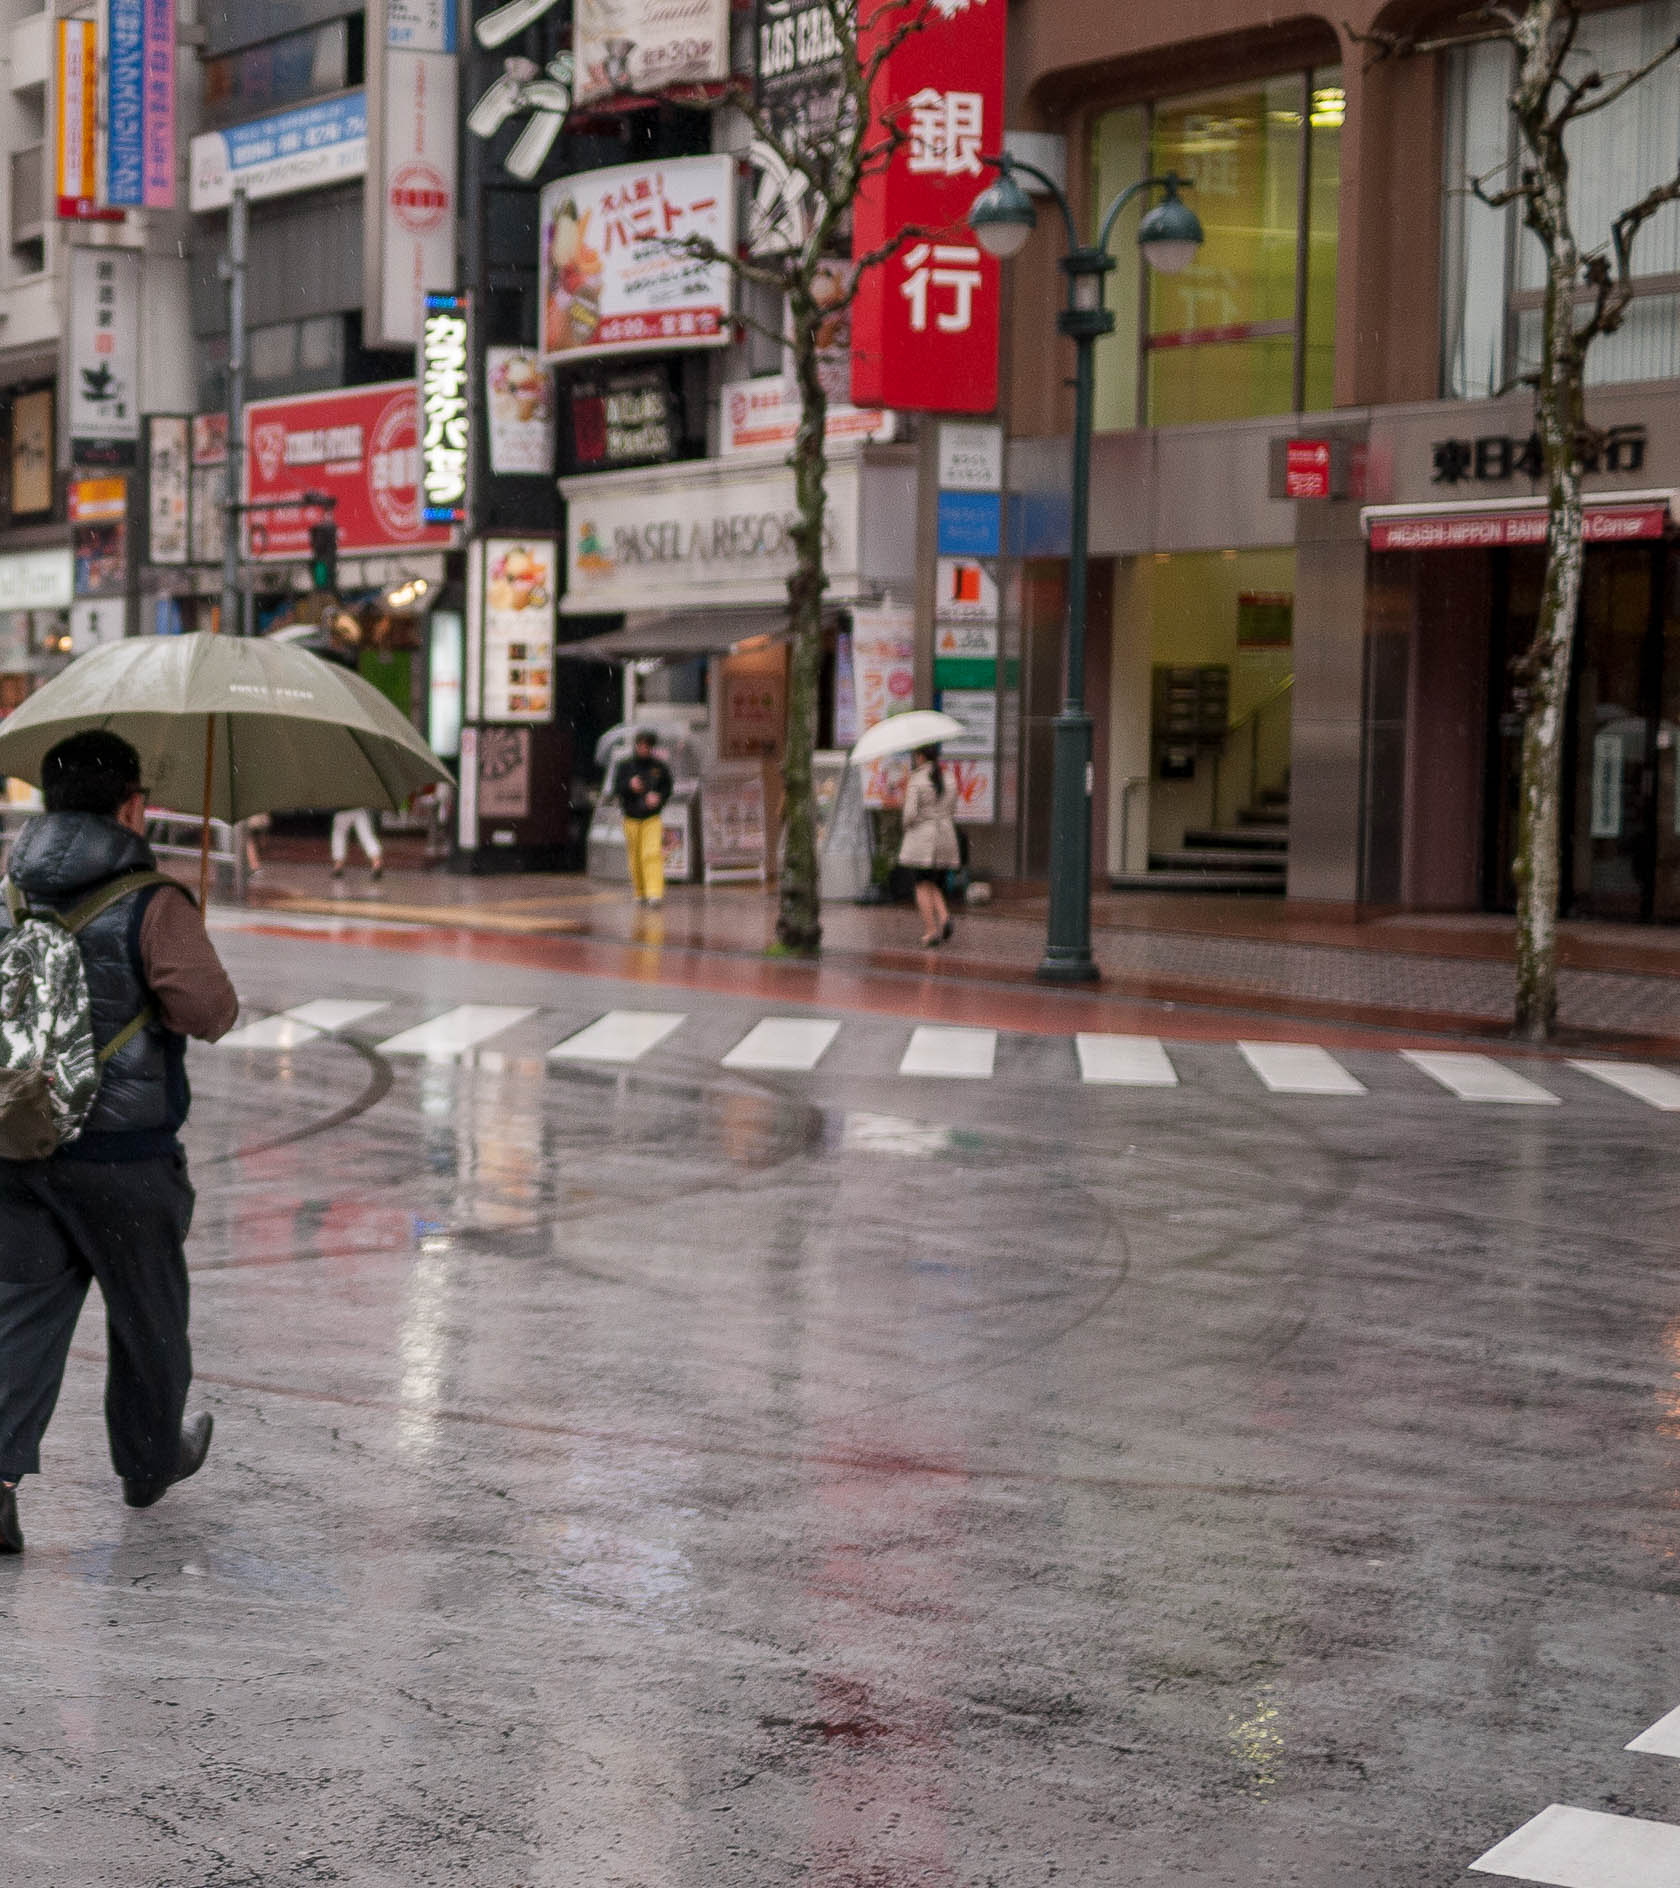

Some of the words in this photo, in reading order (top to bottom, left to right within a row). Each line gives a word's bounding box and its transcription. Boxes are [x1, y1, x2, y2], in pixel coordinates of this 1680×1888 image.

[900, 0, 986, 333] 銀行
[422, 314, 469, 504] カラオケパセラ
[1431, 425, 1647, 486] 東日本行
[613, 519, 709, 563] PASELA
[712, 504, 835, 558] RESORS
